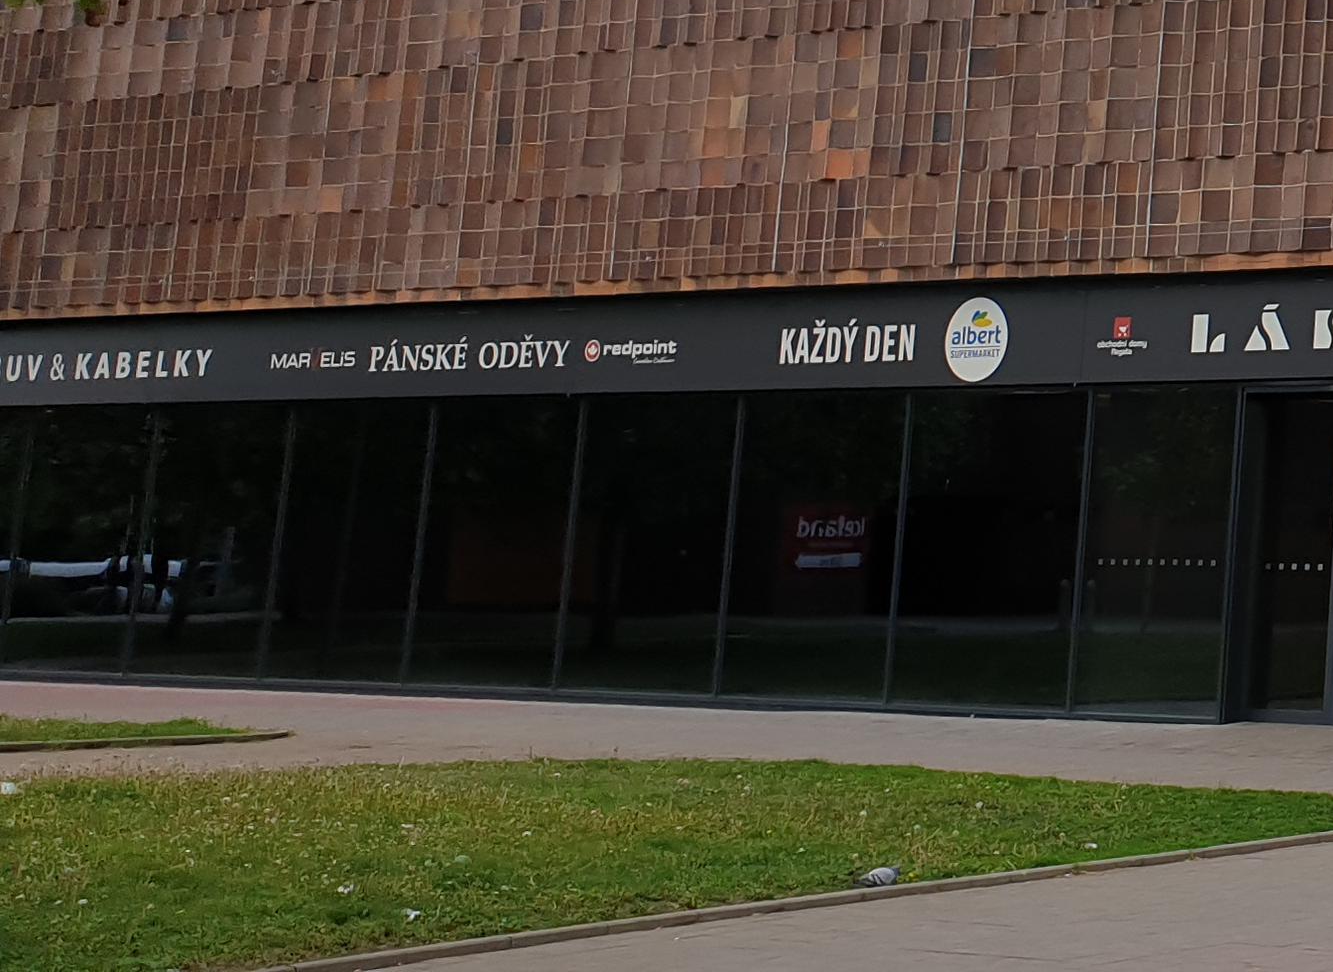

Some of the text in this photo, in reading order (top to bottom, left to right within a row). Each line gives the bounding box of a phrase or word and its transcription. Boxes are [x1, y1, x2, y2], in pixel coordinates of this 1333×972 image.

[602, 339, 678, 360] redpoint
[779, 318, 917, 365] KAŽDÝ DEN
[951, 325, 1002, 346] albert
[0, 348, 213, 383] UV & KABELKY
[368, 334, 571, 373] PÁNSKÉ ODĚVY
[950, 348, 1002, 359] SUPERMARKET
